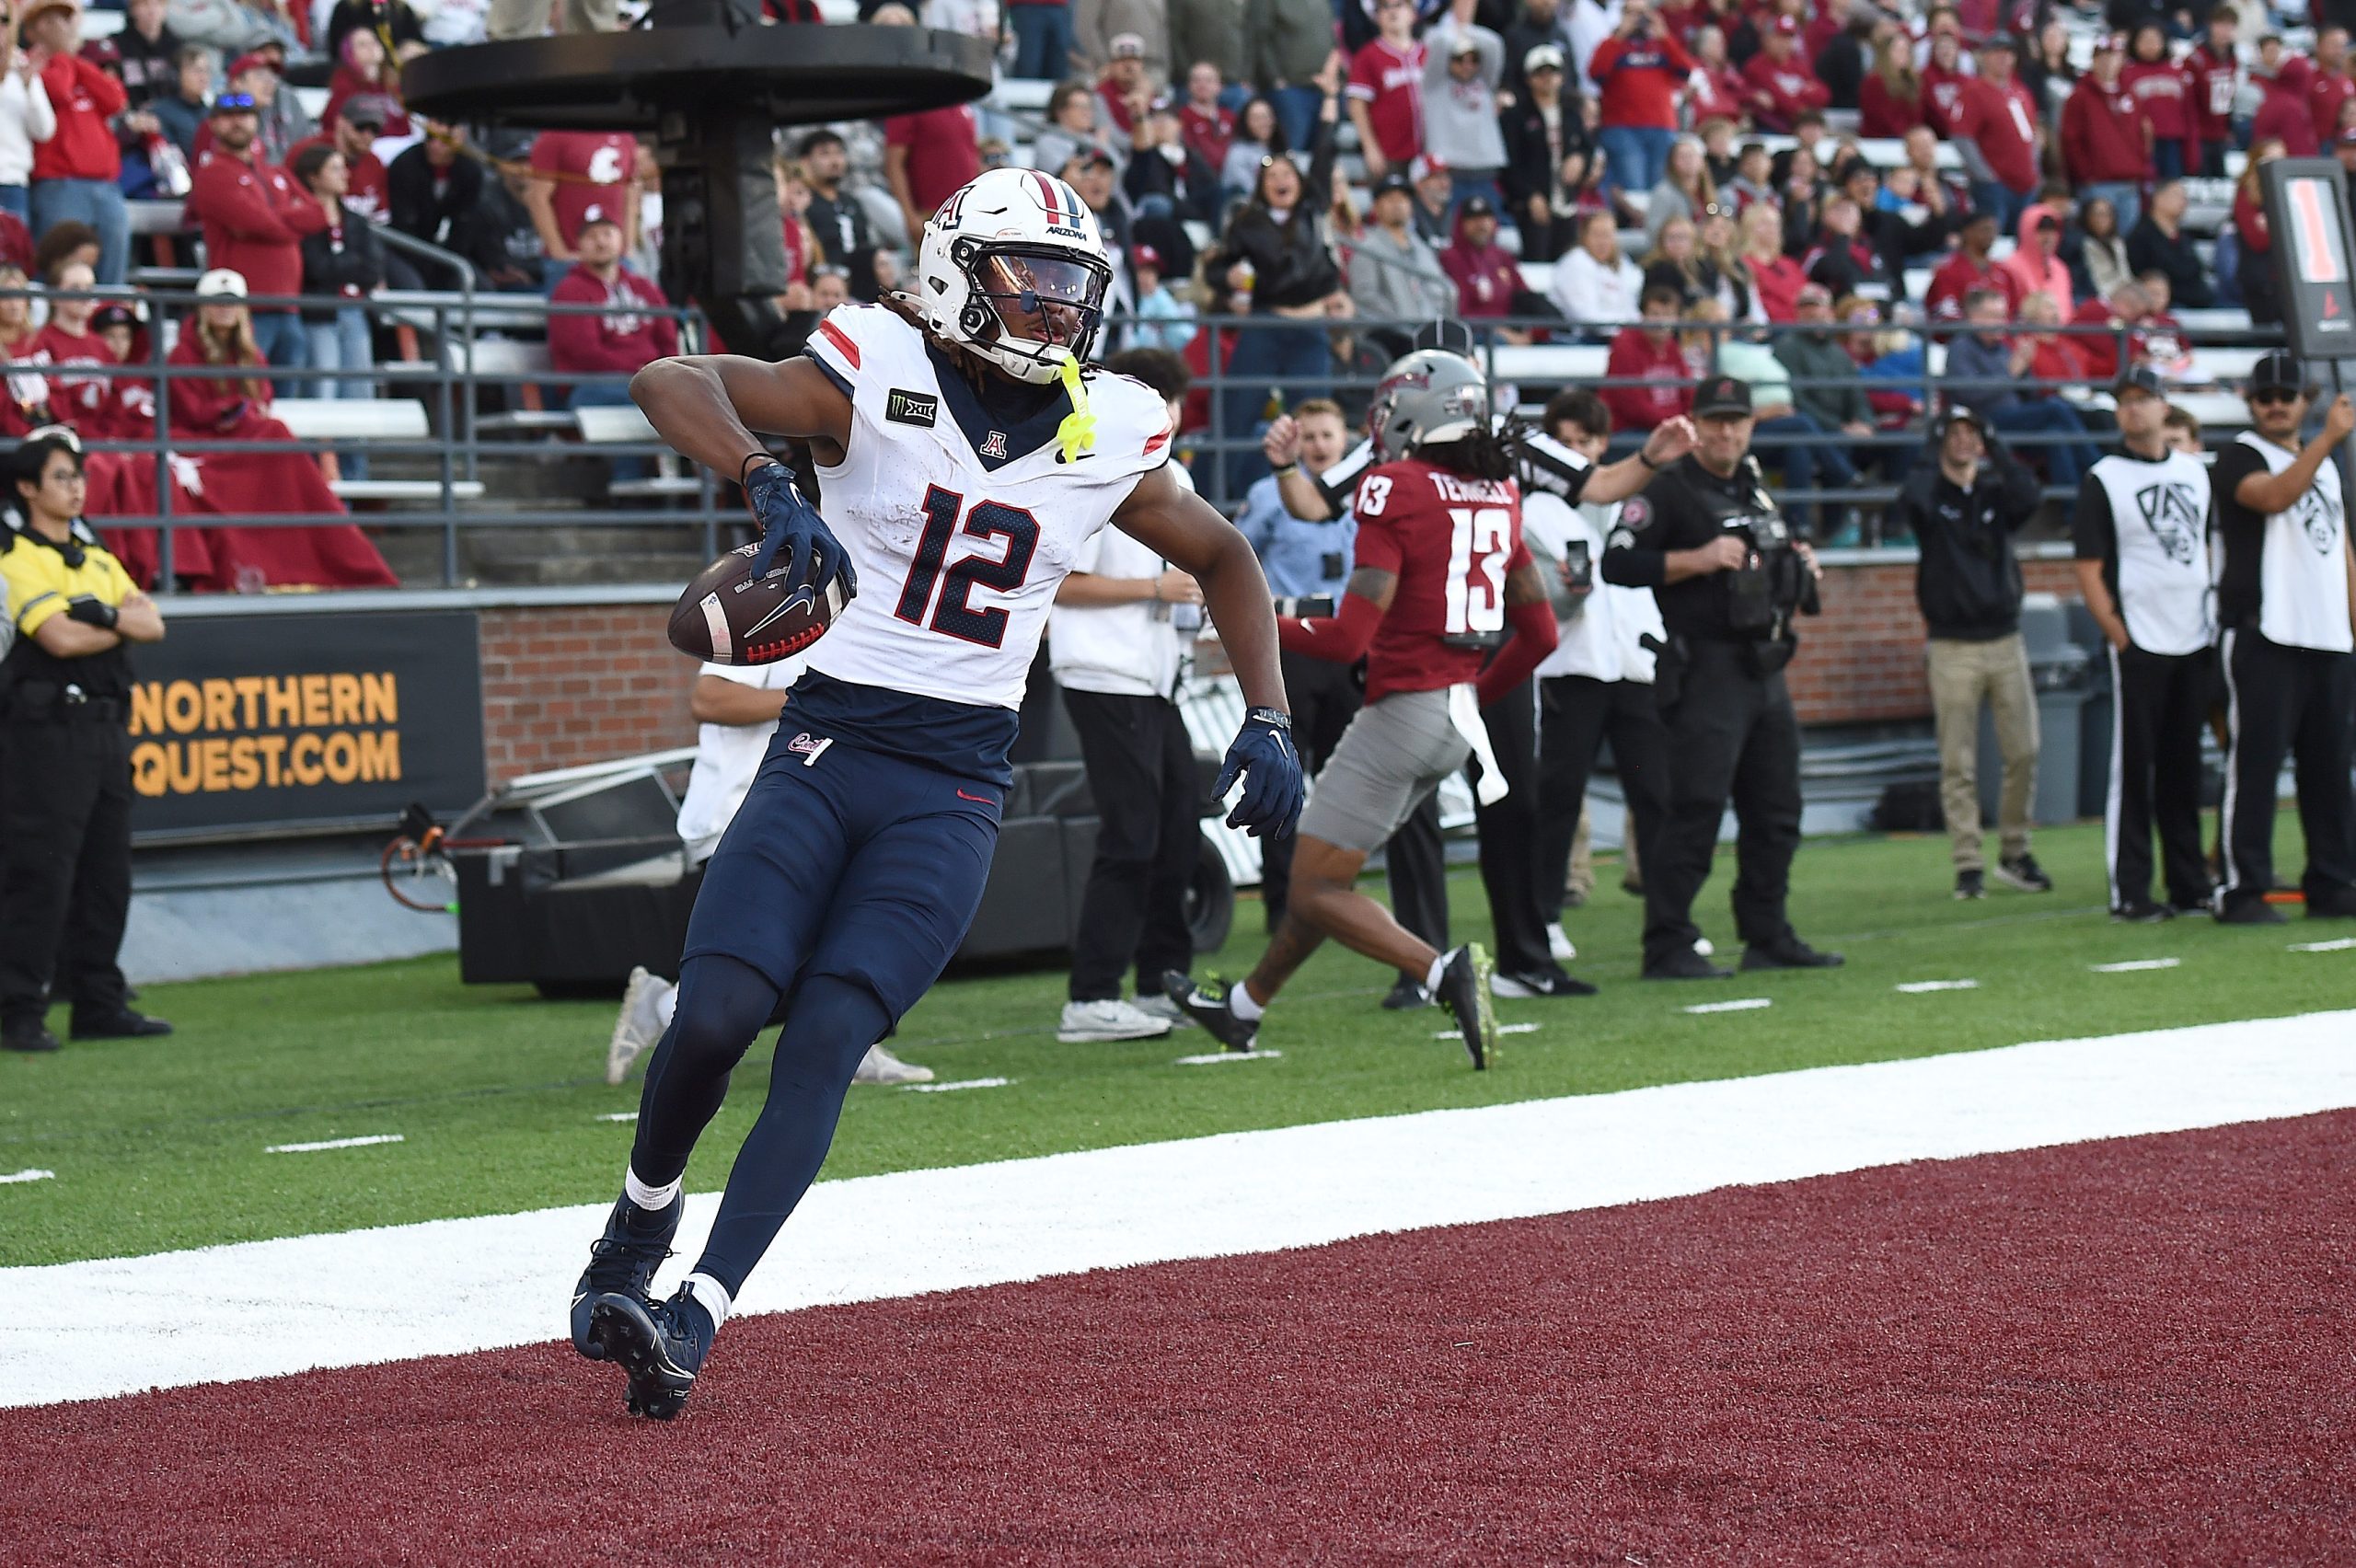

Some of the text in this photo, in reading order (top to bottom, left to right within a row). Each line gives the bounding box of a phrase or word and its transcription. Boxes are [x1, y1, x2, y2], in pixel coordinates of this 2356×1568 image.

[1045, 226, 1088, 242] ARIZONA
[2294, 179, 2338, 280] 1
[980, 430, 1008, 459] A
[1357, 474, 1393, 516] 13
[894, 482, 1041, 650] 12
[1445, 509, 1512, 634] 13
[127, 672, 398, 736] NORTHERN
[130, 730, 401, 797] QUEST.COM
